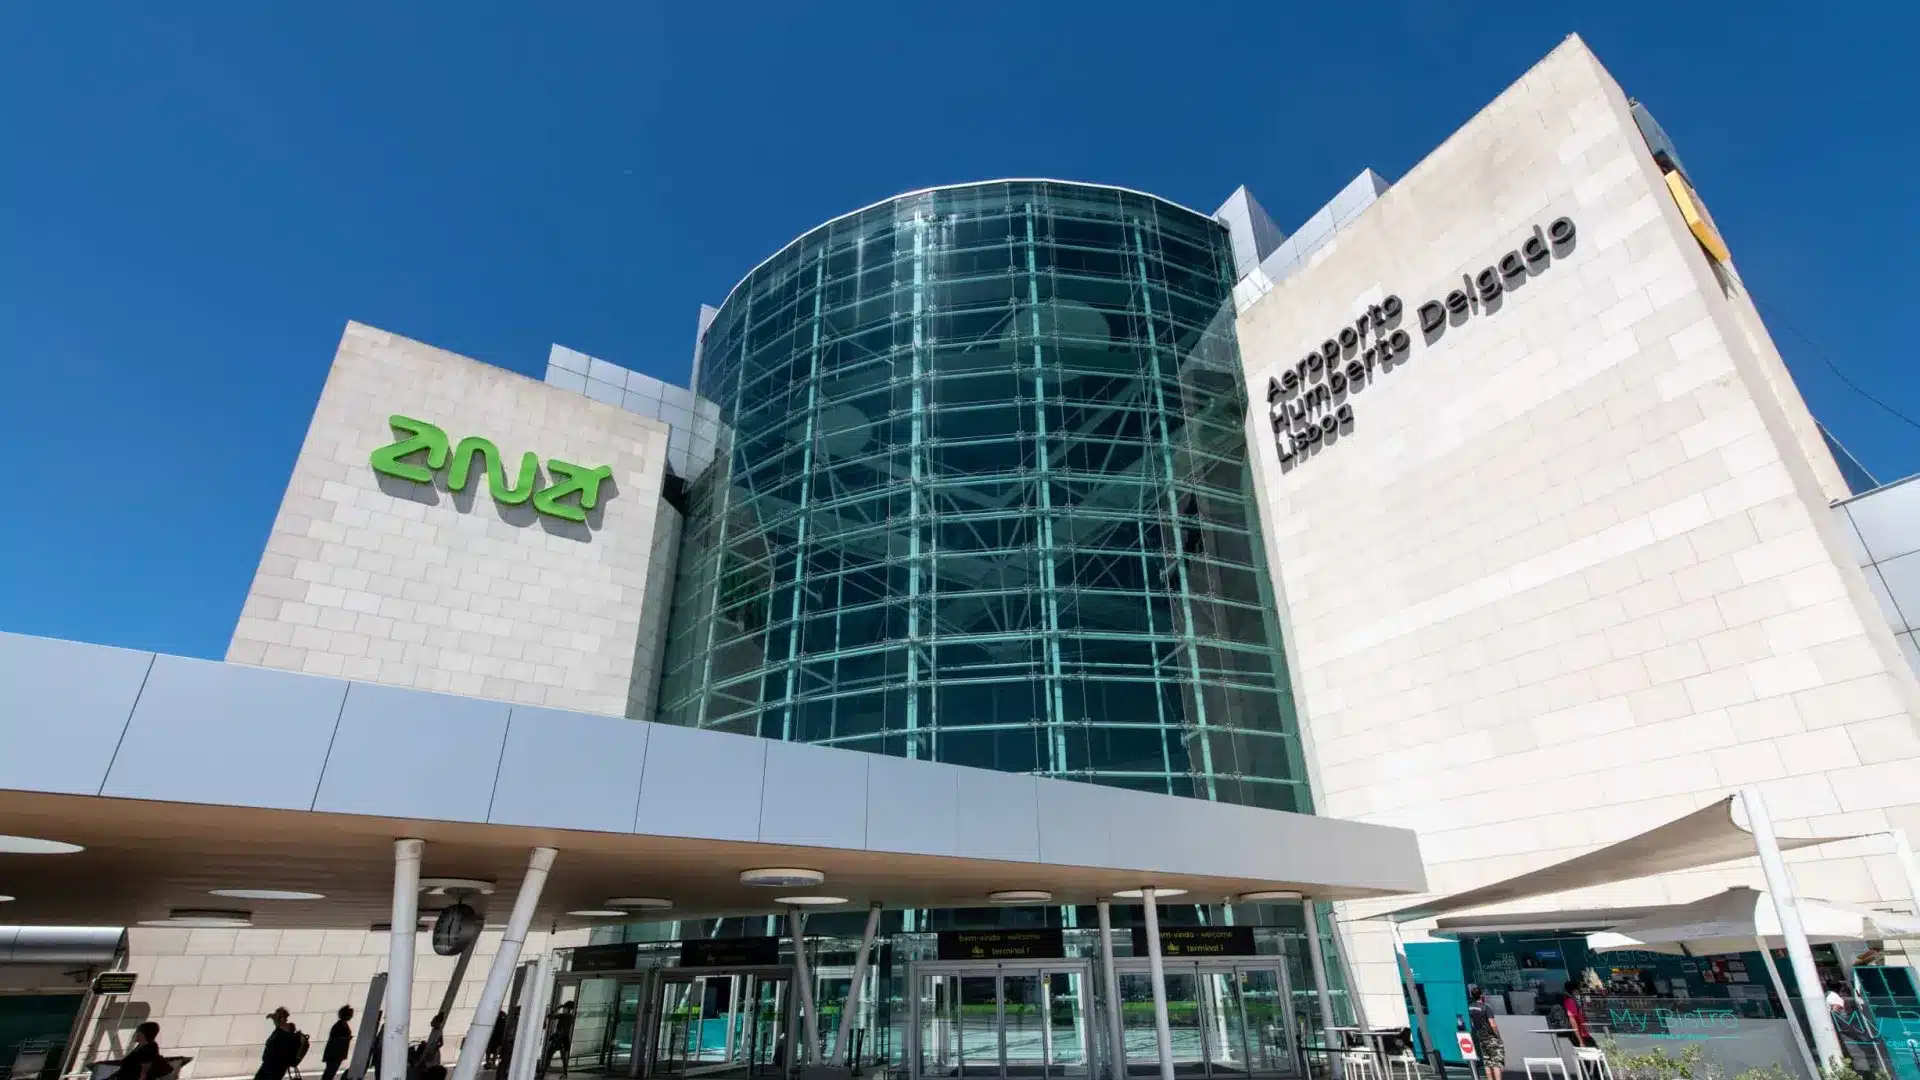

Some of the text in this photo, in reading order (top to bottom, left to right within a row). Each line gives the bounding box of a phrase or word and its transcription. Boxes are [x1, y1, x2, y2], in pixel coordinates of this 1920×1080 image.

[1267, 295, 1403, 402] Aeroporto
[1270, 216, 1576, 436] Humberto Delgado
[1277, 403, 1354, 468] Lisboa
[1610, 1007, 1739, 1032] My Bistro
